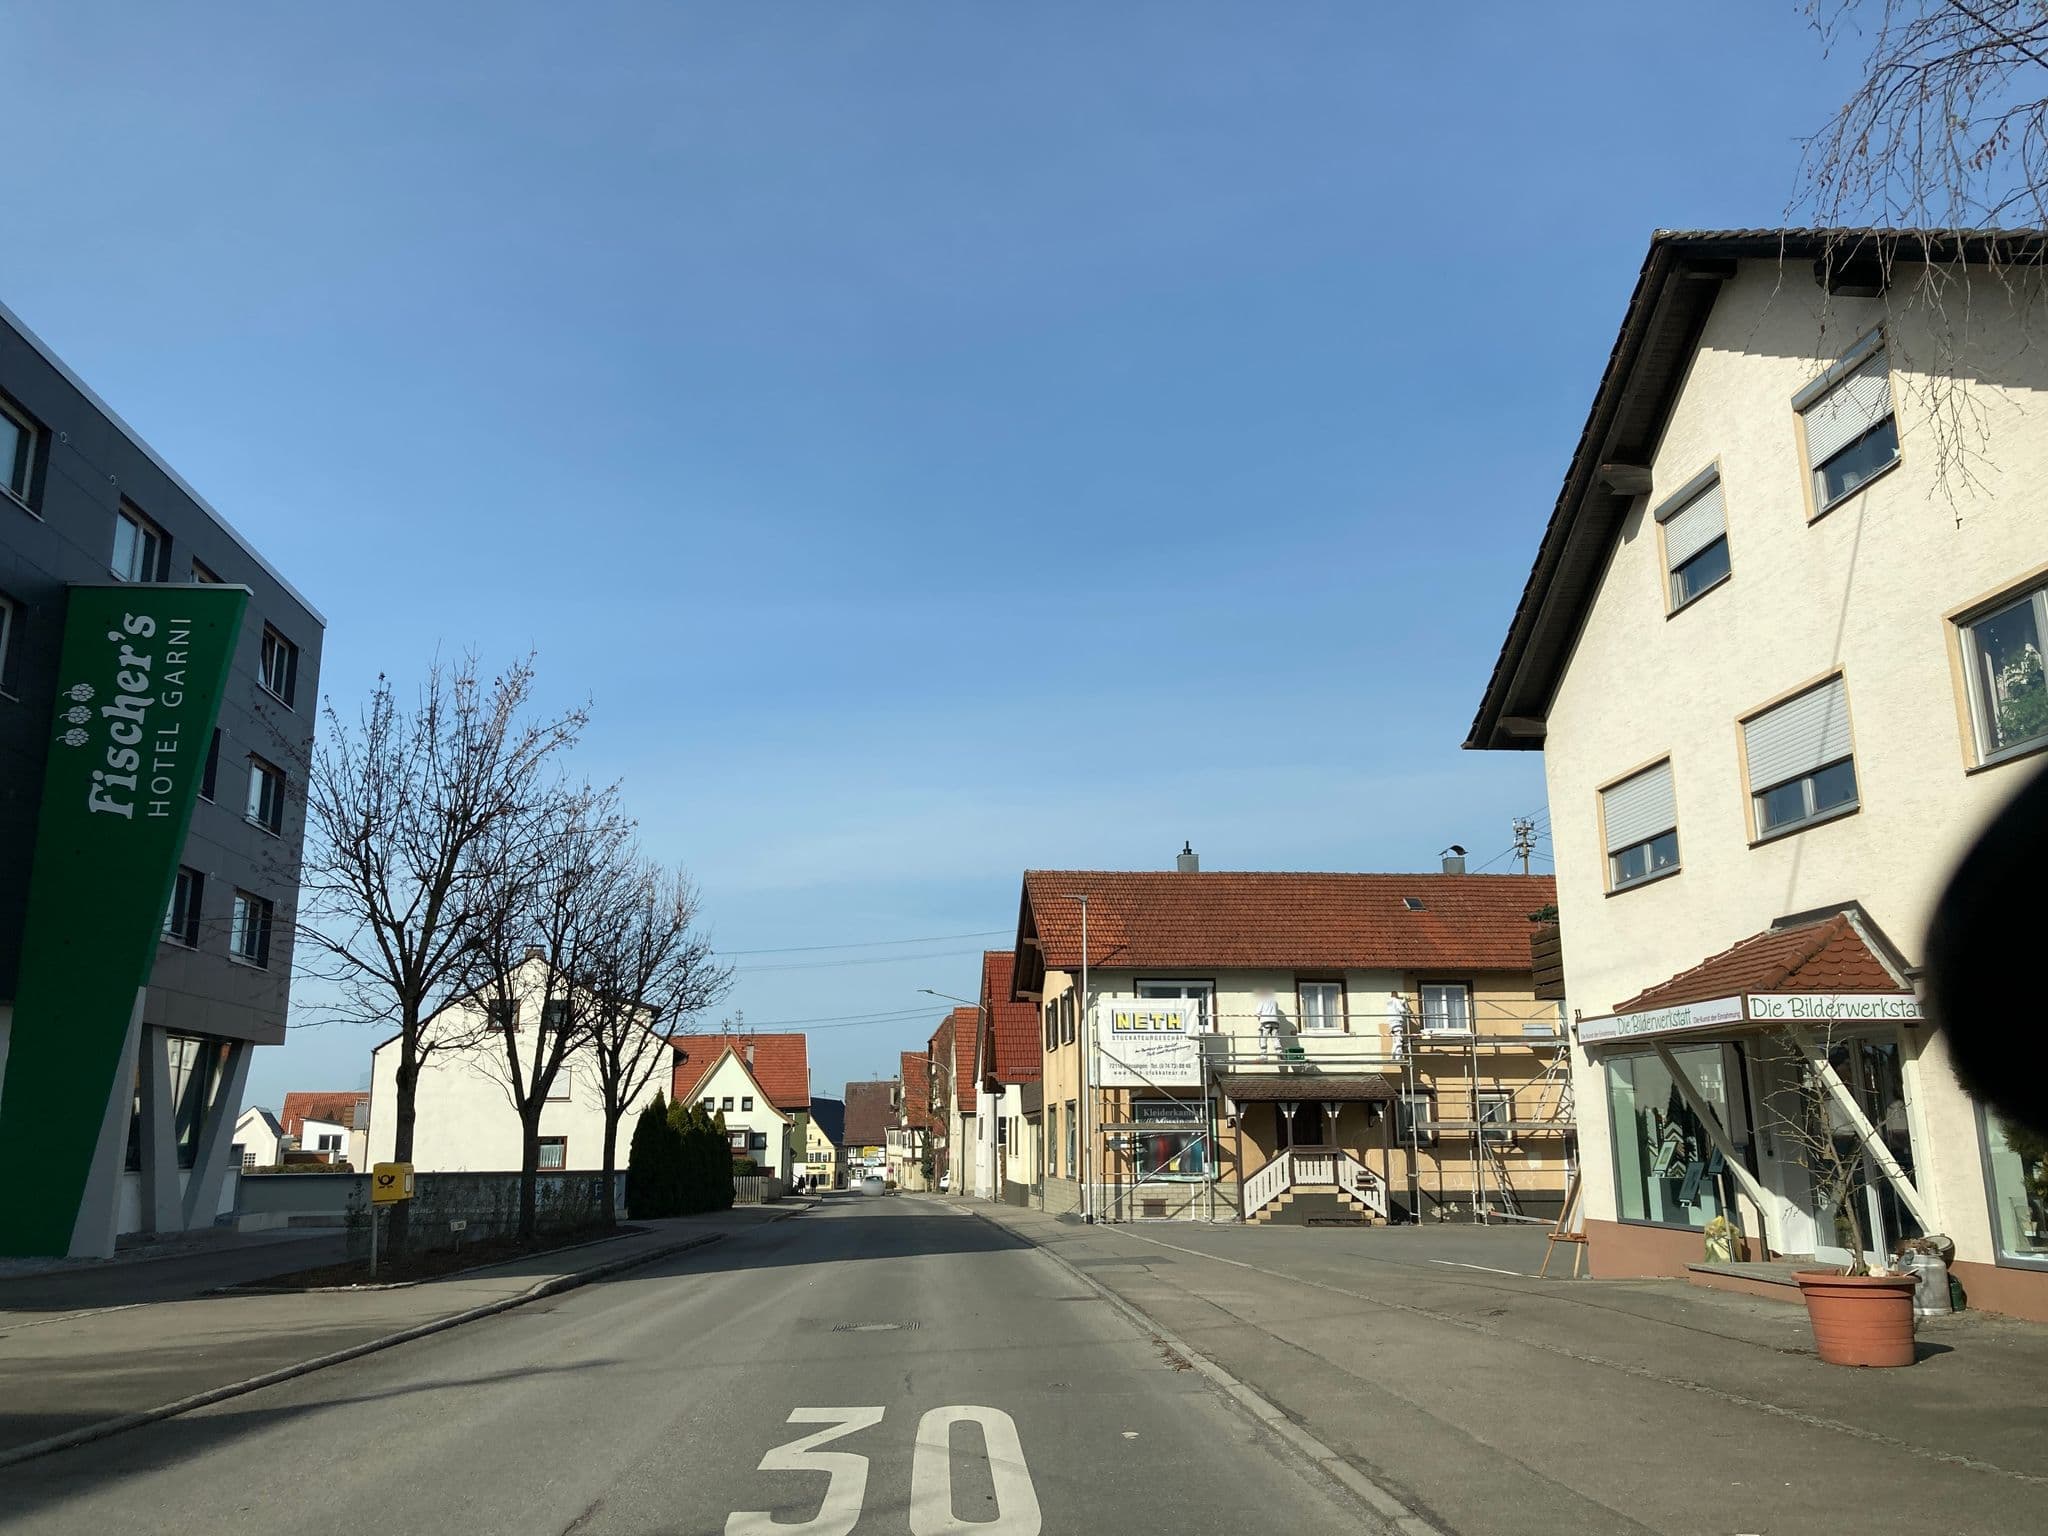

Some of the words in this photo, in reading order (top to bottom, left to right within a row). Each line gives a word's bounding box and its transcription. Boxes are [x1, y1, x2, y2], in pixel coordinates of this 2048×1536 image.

[161, 619, 192, 707] GARNI
[88, 612, 156, 819] Fischer's
[148, 723, 180, 817] HOTEL
[1115, 1012, 1182, 1030] NETH
[1616, 1017, 1631, 1035] Die
[1631, 1008, 1693, 1033] Bilderwerkstatt
[1751, 997, 1784, 1018] Die
[1787, 996, 1924, 1018] Bilderwerkstat
[724, 1405, 1042, 1536] 30
